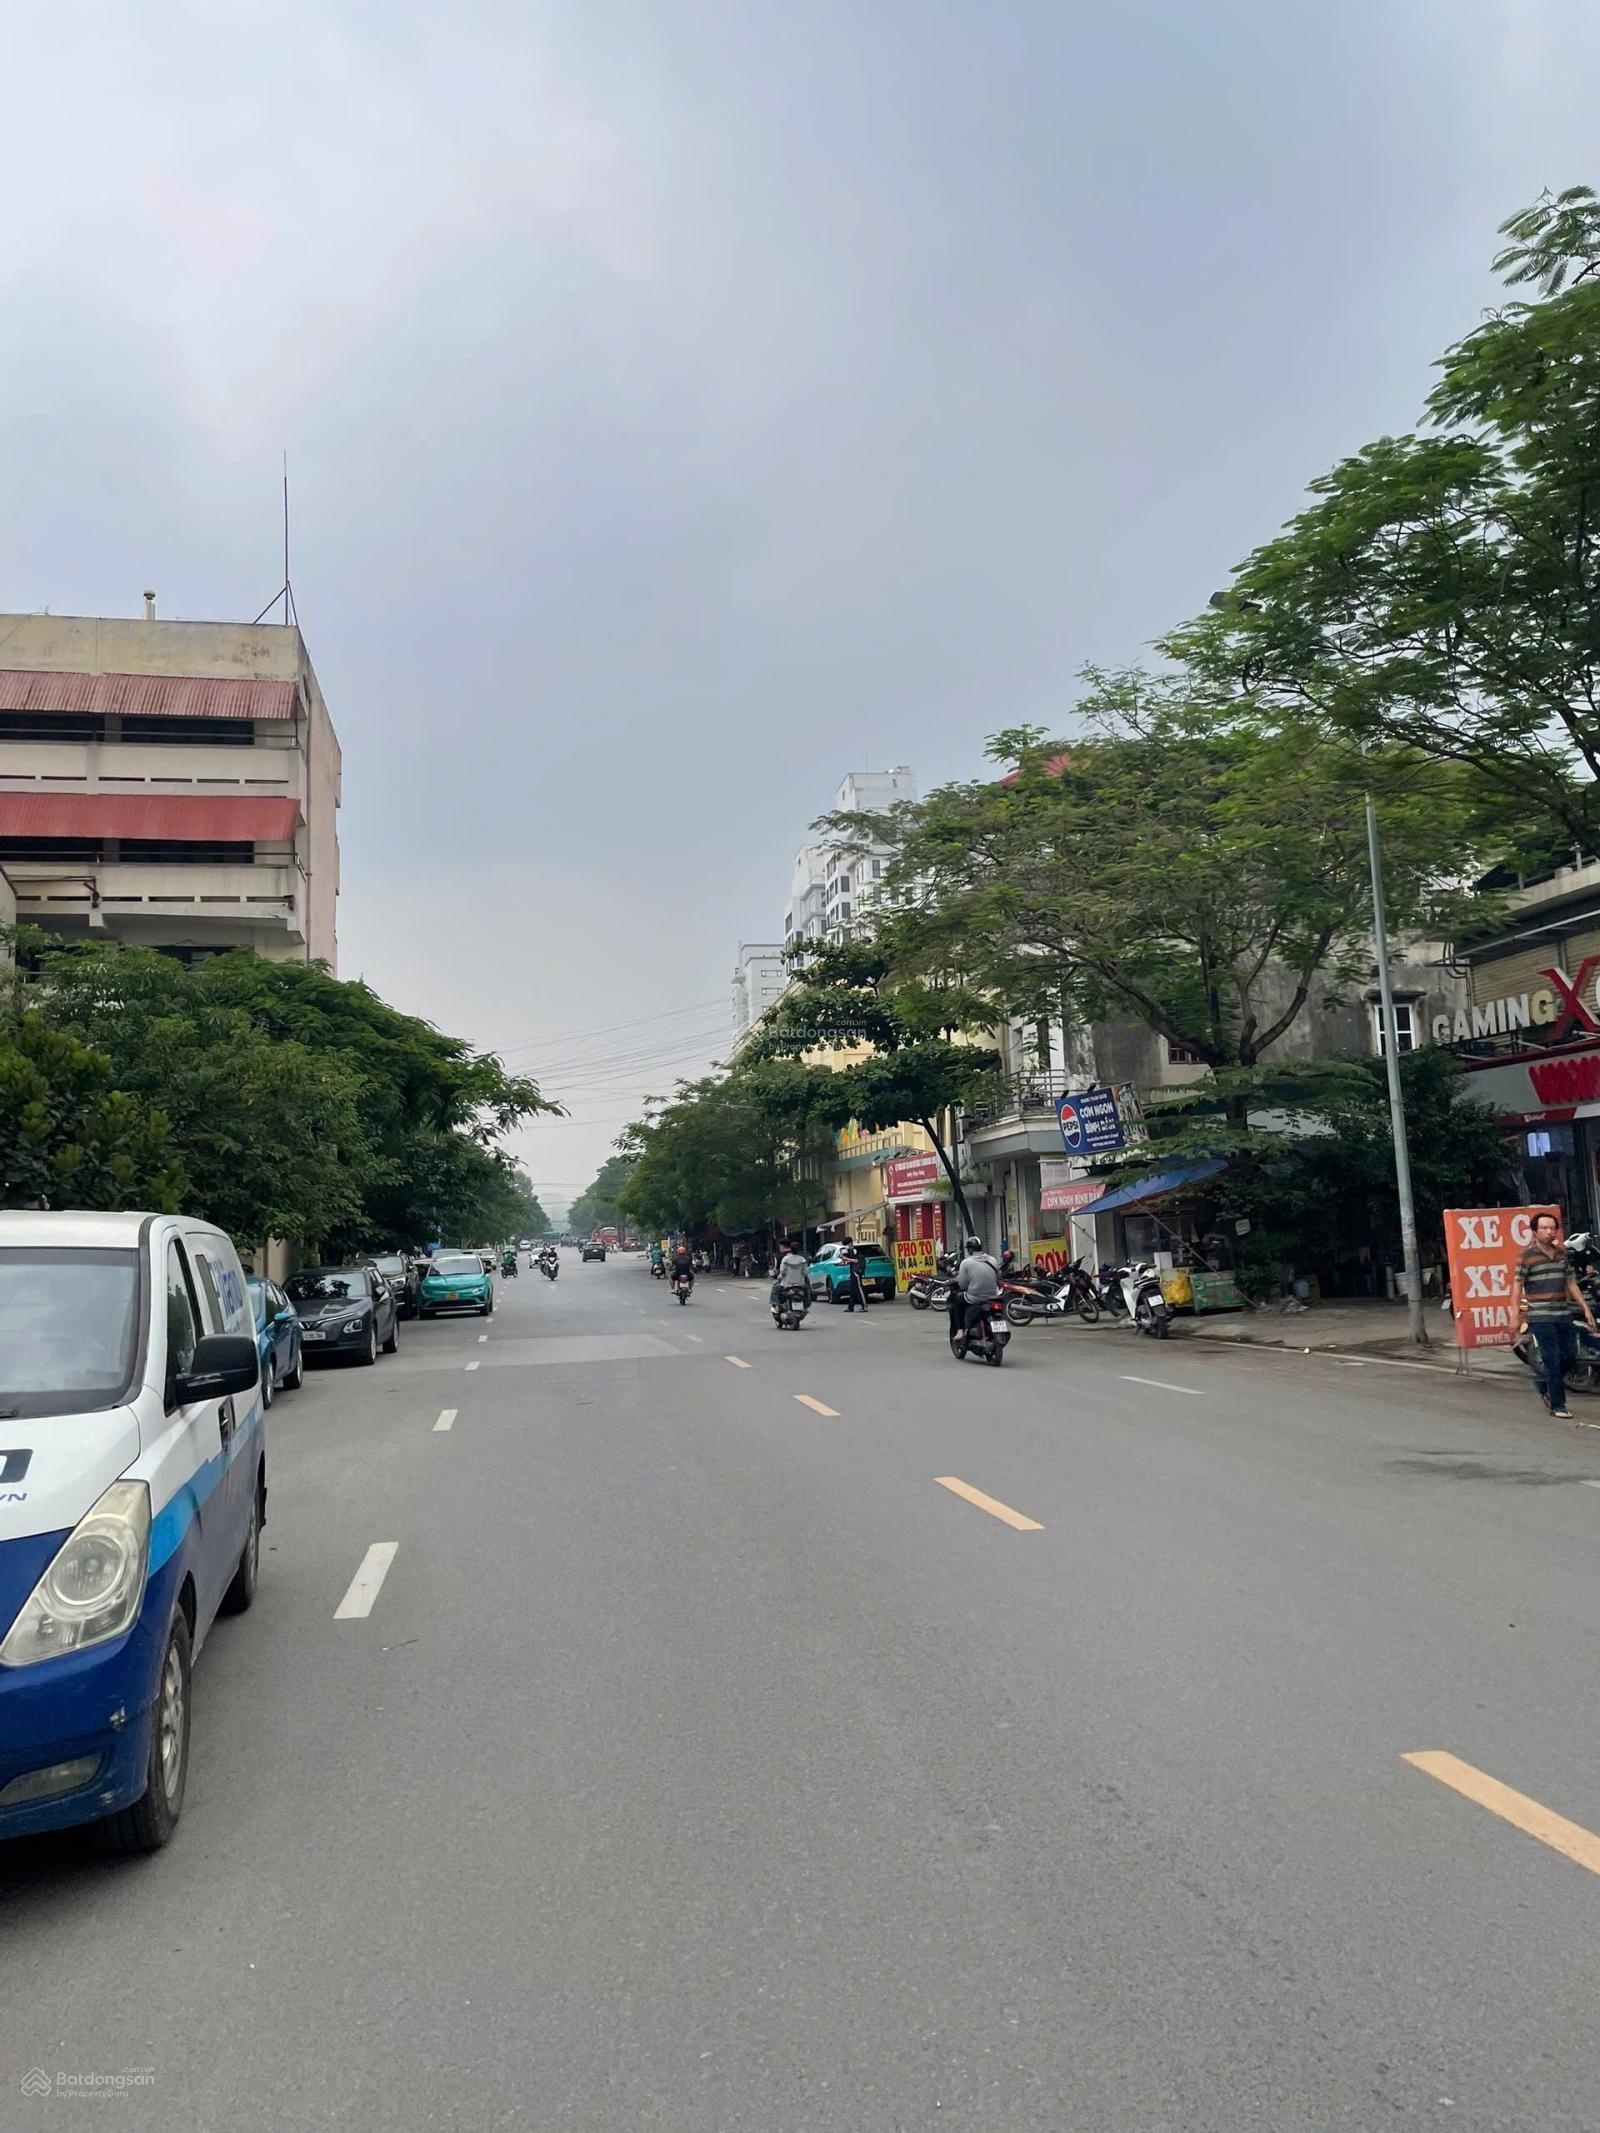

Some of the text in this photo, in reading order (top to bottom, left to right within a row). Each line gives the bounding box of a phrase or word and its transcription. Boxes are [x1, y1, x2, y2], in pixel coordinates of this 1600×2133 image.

[1432, 989, 1557, 1045] GAMING
[1062, 1120, 1079, 1131] PEPSI
[919, 1240, 933, 1256] TO
[1458, 1214, 1533, 1249] XE G
[1464, 1264, 1511, 1298] XE
